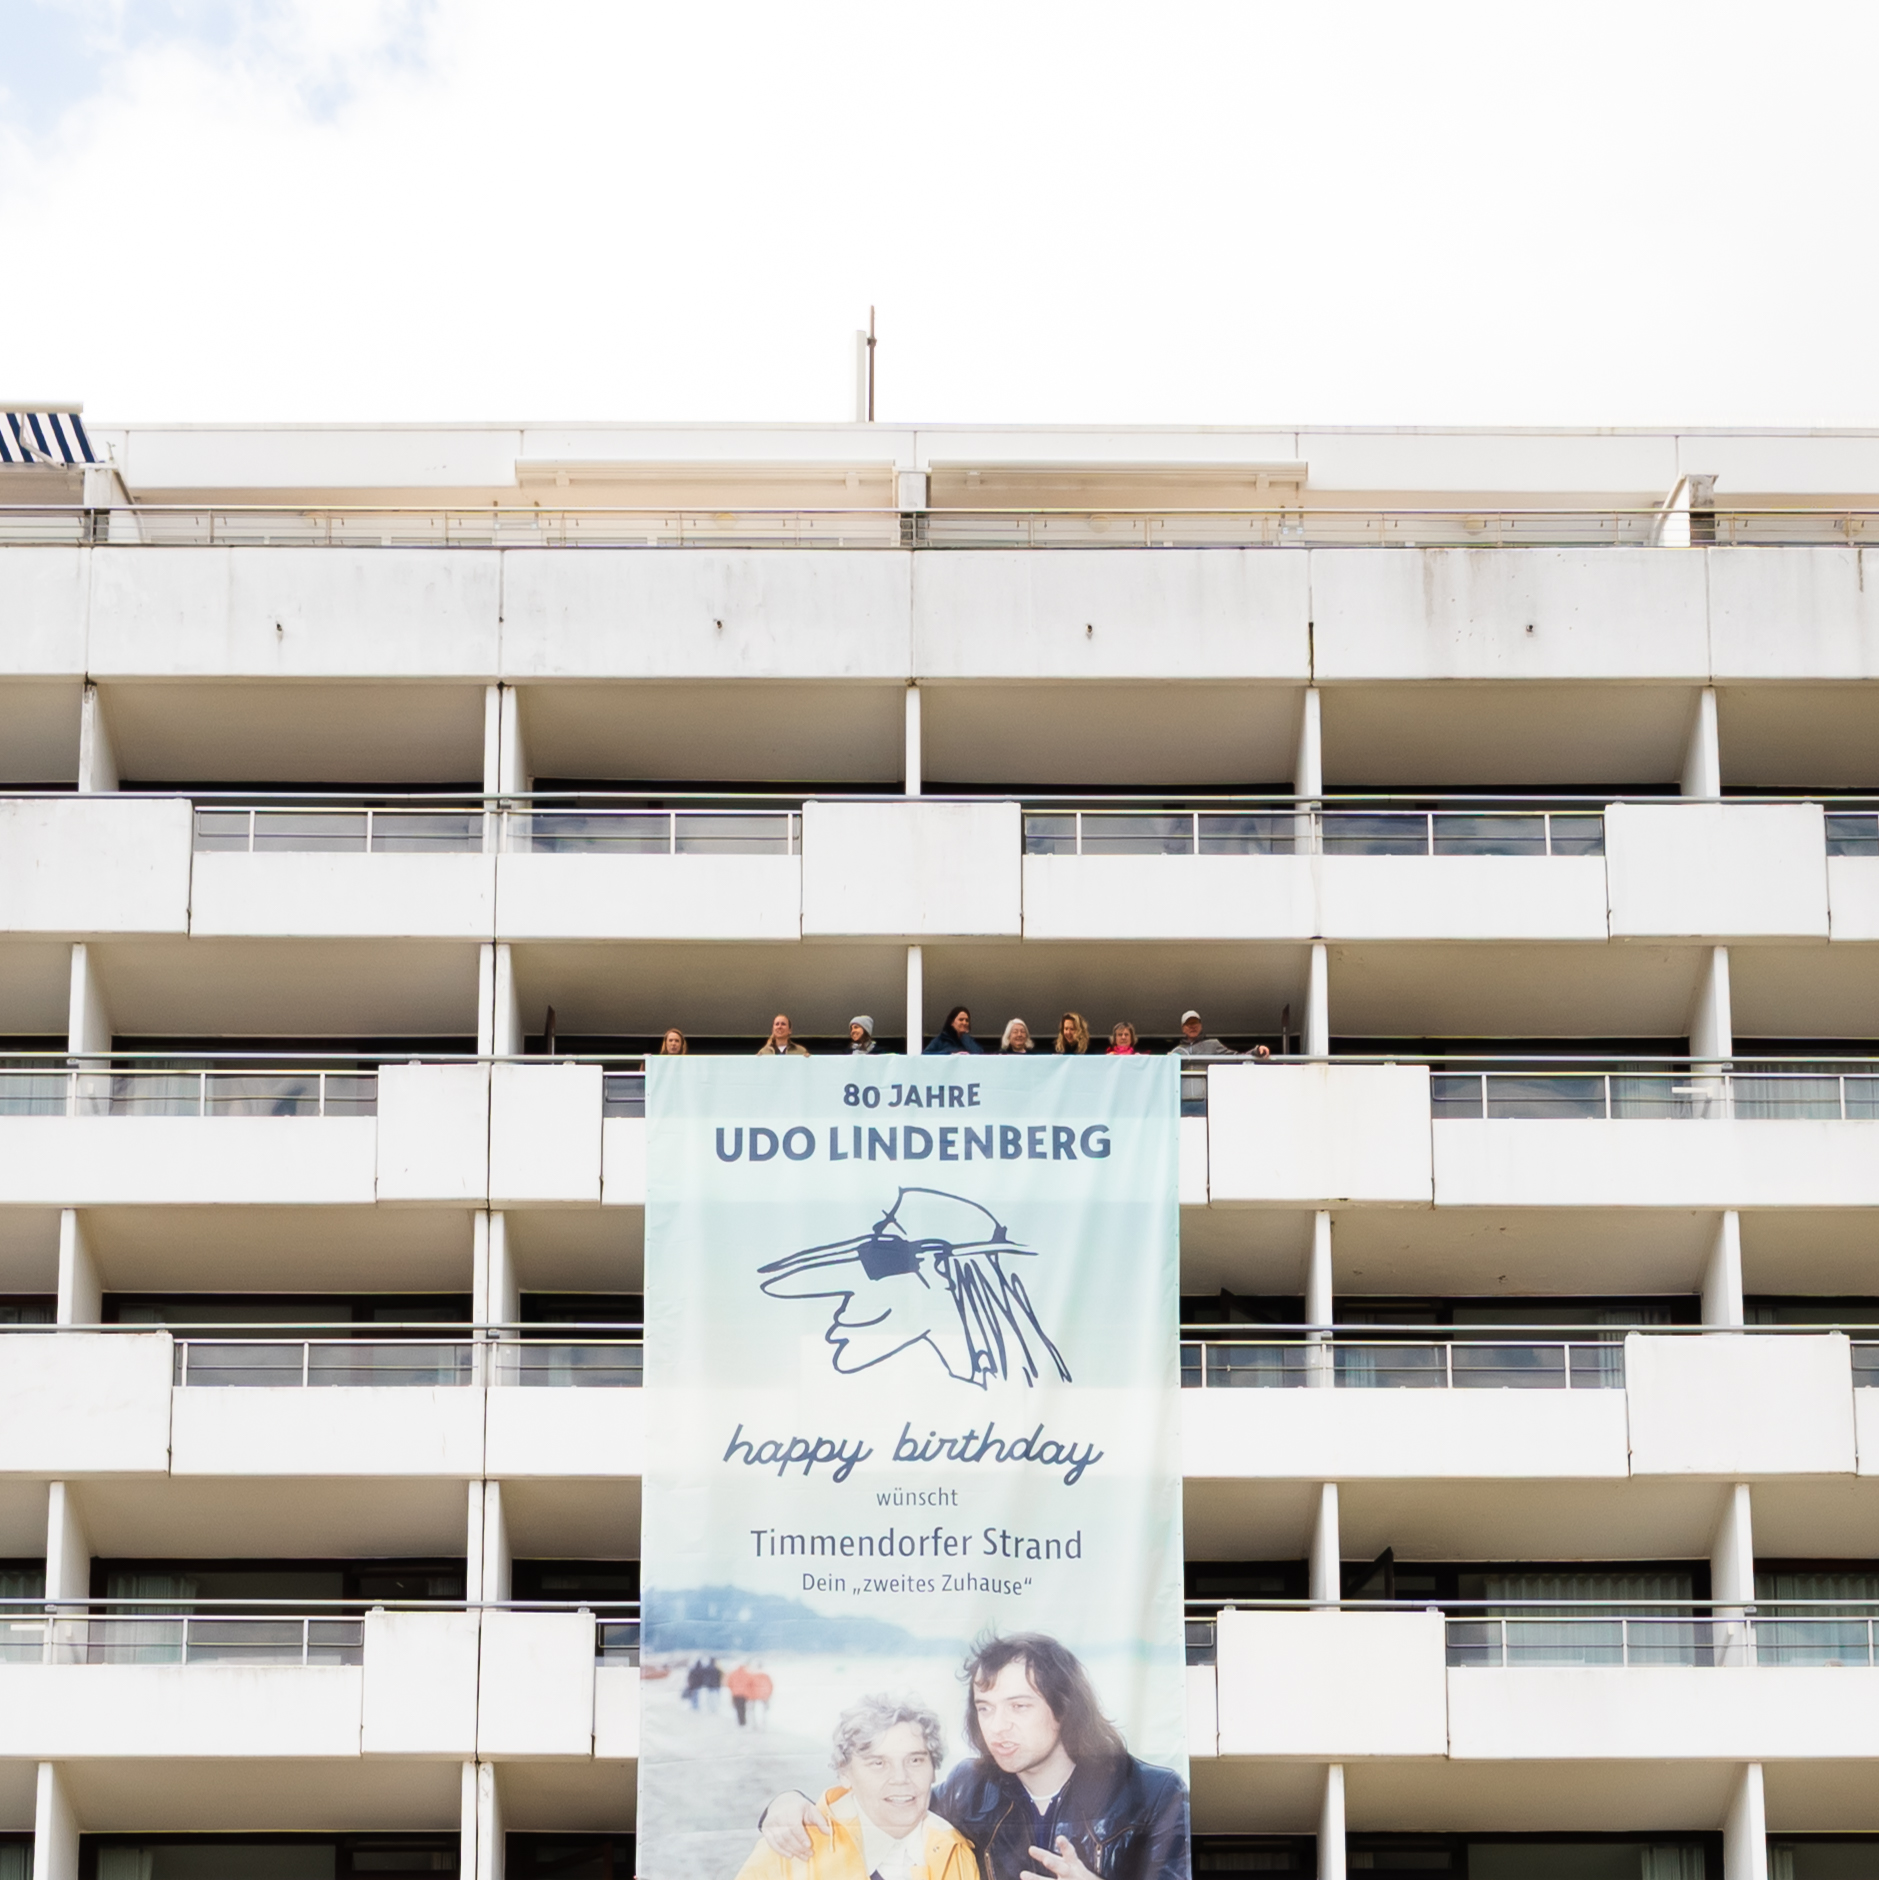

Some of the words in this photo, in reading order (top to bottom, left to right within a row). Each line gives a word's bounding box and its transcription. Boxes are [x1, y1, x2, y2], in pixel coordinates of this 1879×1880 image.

[843, 1083, 880, 1108] 80
[887, 1082, 981, 1107] JAHRE
[715, 1126, 816, 1162] UDO
[829, 1124, 1111, 1162] LINDENBERG
[722, 1424, 873, 1483] happy
[892, 1422, 1104, 1486] birthday
[876, 1487, 958, 1507] wünscht
[750, 1526, 973, 1558] Timmendorfer
[983, 1527, 1082, 1560] Strand
[802, 1573, 846, 1592] Dein
